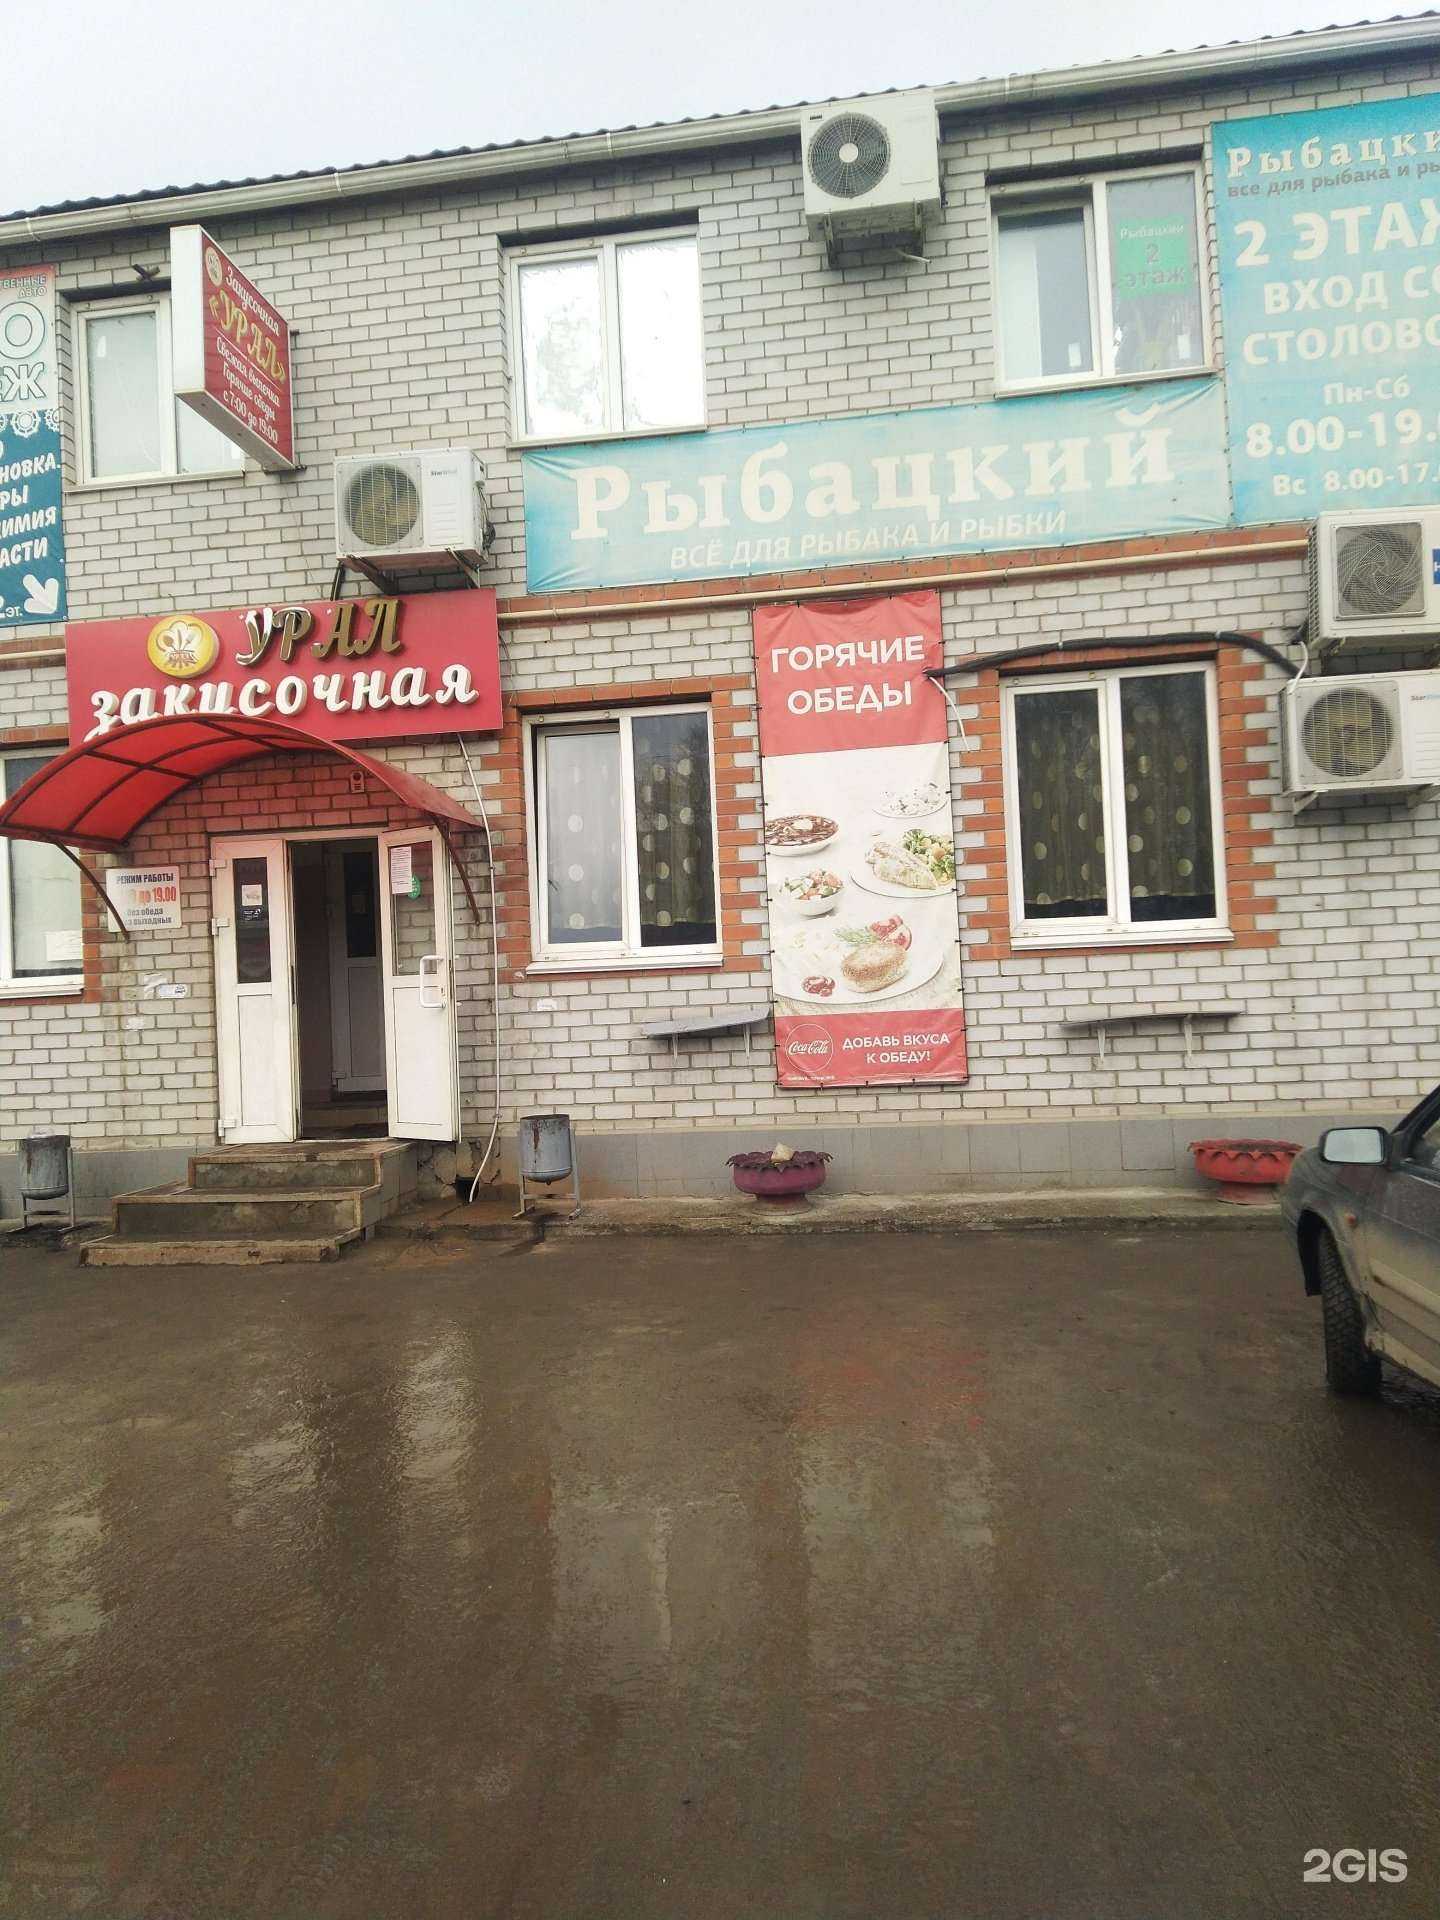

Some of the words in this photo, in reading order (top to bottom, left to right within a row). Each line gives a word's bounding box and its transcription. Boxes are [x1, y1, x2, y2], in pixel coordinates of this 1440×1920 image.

[1228, 182, 1260, 197] все
[1267, 178, 1305, 197] для
[1311, 166, 1391, 192] рыбака
[1397, 165, 1410, 177] и
[1145, 241, 1160, 263] 2
[1233, 220, 1270, 267] 2
[0, 273, 46, 289] ВЕННЫЕ
[18, 286, 47, 298] АВТО
[1264, 270, 1388, 315] ВХОД
[226, 266, 280, 336] Закусочная
[217, 336, 248, 378] Свежая
[249, 367, 280, 407] выпечка
[223, 361, 253, 399] Горячие
[254, 393, 275, 421] обеды
[1323, 374, 1410, 406] Пн-Сб
[247, 412, 257, 428] до
[1246, 408, 1440, 458] 8.00-19.
[568, 403, 1176, 542] Рыбацкий
[1272, 474, 1307, 496] Вс
[1323, 462, 1440, 492] 8.00-17.
[0, 506, 56, 539] ИМИЯ
[671, 538, 722, 571] ВСЁ
[728, 536, 790, 568] ДЛЯ
[801, 525, 919, 557] РЫБАКА
[929, 520, 950, 545] И
[961, 509, 1066, 539] РЫБКИ
[235, 599, 405, 667] УРАЛ
[771, 635, 926, 673] ГОРЯЧИЕ
[787, 680, 912, 715] ОБЕДЫ
[143, 873, 174, 882] РАБОТЫ
[141, 907, 163, 916] обеда
[788, 1039, 832, 1056] Coca-Cola
[842, 1035, 899, 1050] ДОБАВЬ
[903, 1033, 950, 1047] ВКУСА
[866, 1053, 876, 1064] К
[879, 1051, 931, 1064] ОБЕДУ!
